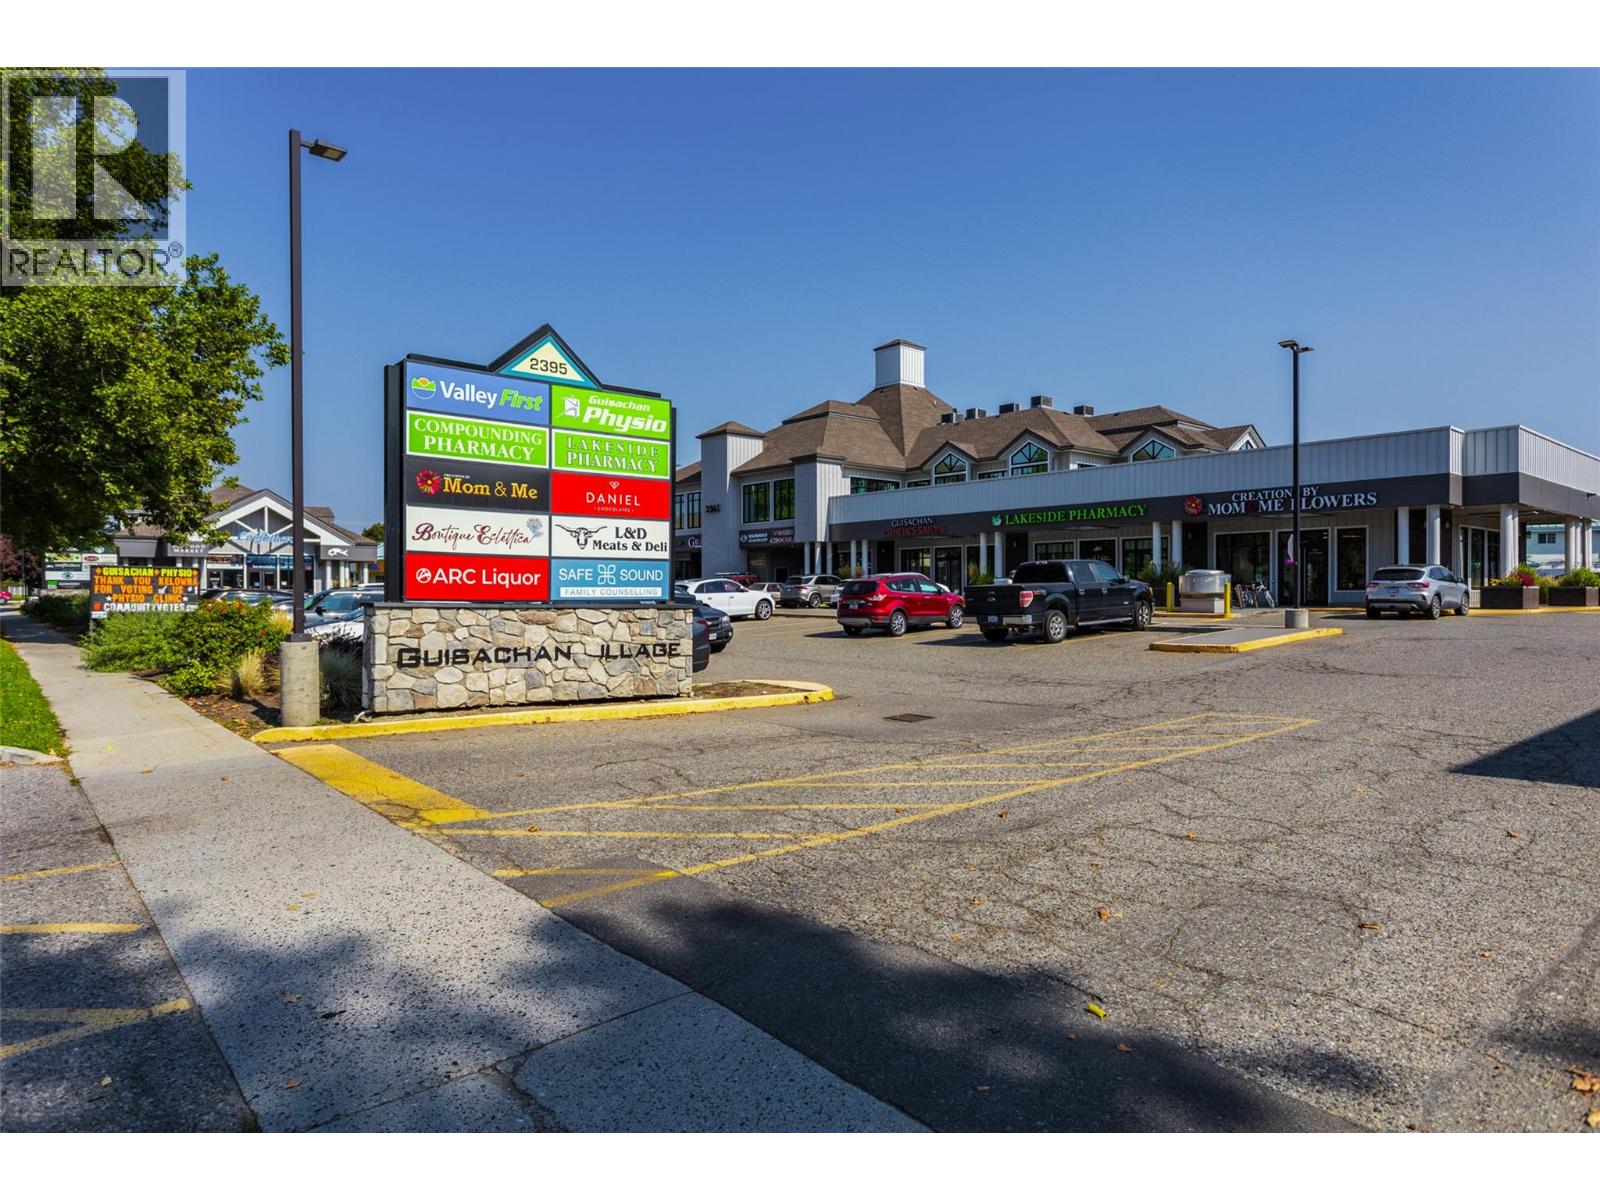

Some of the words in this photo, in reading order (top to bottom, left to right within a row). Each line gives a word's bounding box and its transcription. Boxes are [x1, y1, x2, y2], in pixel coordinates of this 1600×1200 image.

[530, 358, 568, 375] 2395
[440, 381, 498, 409] Valley
[499, 389, 544, 411] First
[588, 395, 651, 412] Guisachan
[582, 406, 667, 433] Physio
[414, 418, 542, 446] COMPOUNDING
[423, 435, 535, 461] PHARMACY
[567, 437, 659, 458] LAKESIDE
[567, 451, 659, 473] PHARMACY
[443, 477, 491, 496] Mom
[494, 481, 507, 497] &
[511, 482, 538, 499] Me
[1302, 486, 1319, 496] BY
[585, 491, 640, 507] DANIEL
[1208, 502, 1246, 516] MOM
[1258, 499, 1284, 512] ME
[1005, 511, 1066, 525] LAKESIDE
[1069, 504, 1147, 520] PHARMACY
[411, 522, 475, 551] Boutique
[615, 526, 647, 540] L&D
[592, 540, 628, 551] Meats
[631, 541, 642, 552] &
[645, 541, 668, 553] Deli
[102, 567, 153, 577] GUISACHAN
[160, 568, 192, 577] PHYSIO
[432, 567, 477, 585] ARC
[481, 567, 541, 590] Liquor
[558, 568, 594, 581] SAFE
[619, 569, 663, 581] SOUND
[94, 576, 125, 585] THANK
[132, 577, 151, 585] YOU
[158, 577, 198, 586] KELOWNA
[94, 585, 112, 594] FOR
[120, 585, 153, 594] VOTING
[172, 586, 183, 594] US
[111, 594, 145, 603] PHYSIO
[153, 595, 181, 603] CLINIC
[564, 588, 596, 596] FAMILY
[600, 588, 658, 596] COUNSELLING
[396, 644, 572, 669] GUISACHAN
